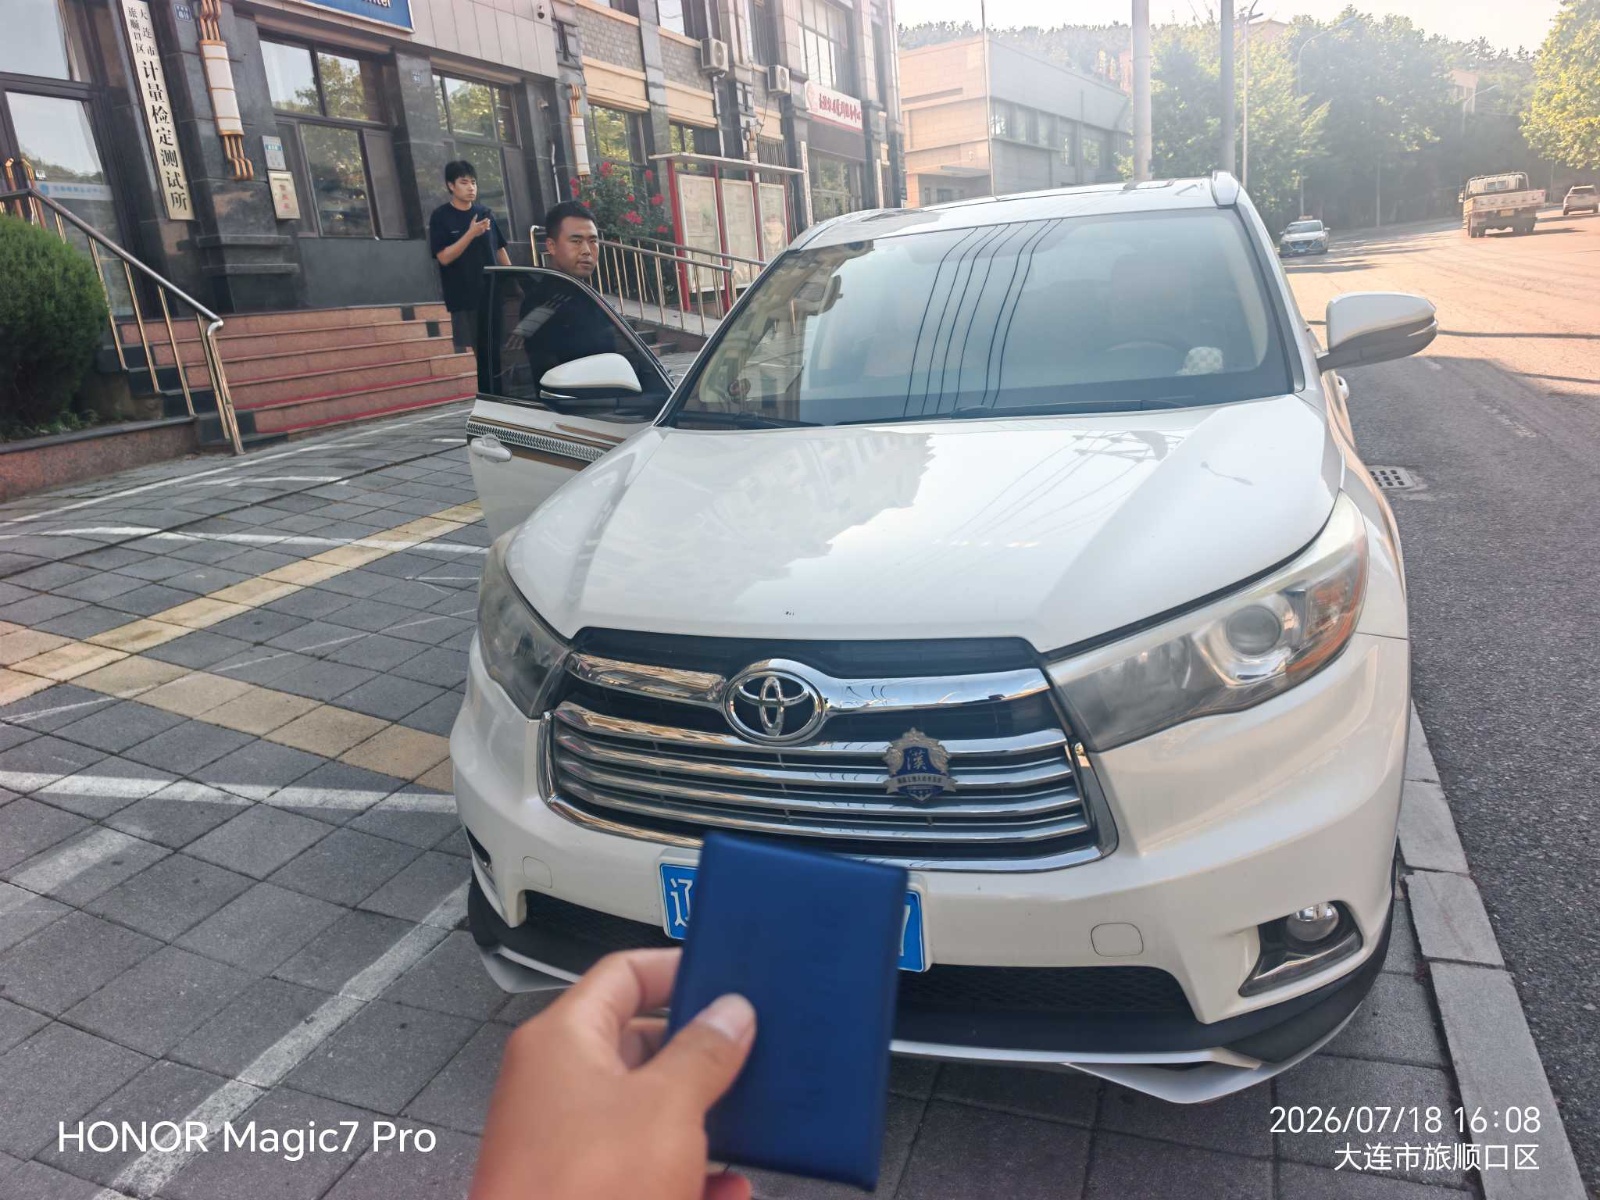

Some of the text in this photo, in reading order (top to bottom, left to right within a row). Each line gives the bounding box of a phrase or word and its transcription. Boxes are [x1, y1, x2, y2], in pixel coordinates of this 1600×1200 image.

[140, 8, 155, 56] 大连市
[142, 60, 188, 211] 计量检定测试所
